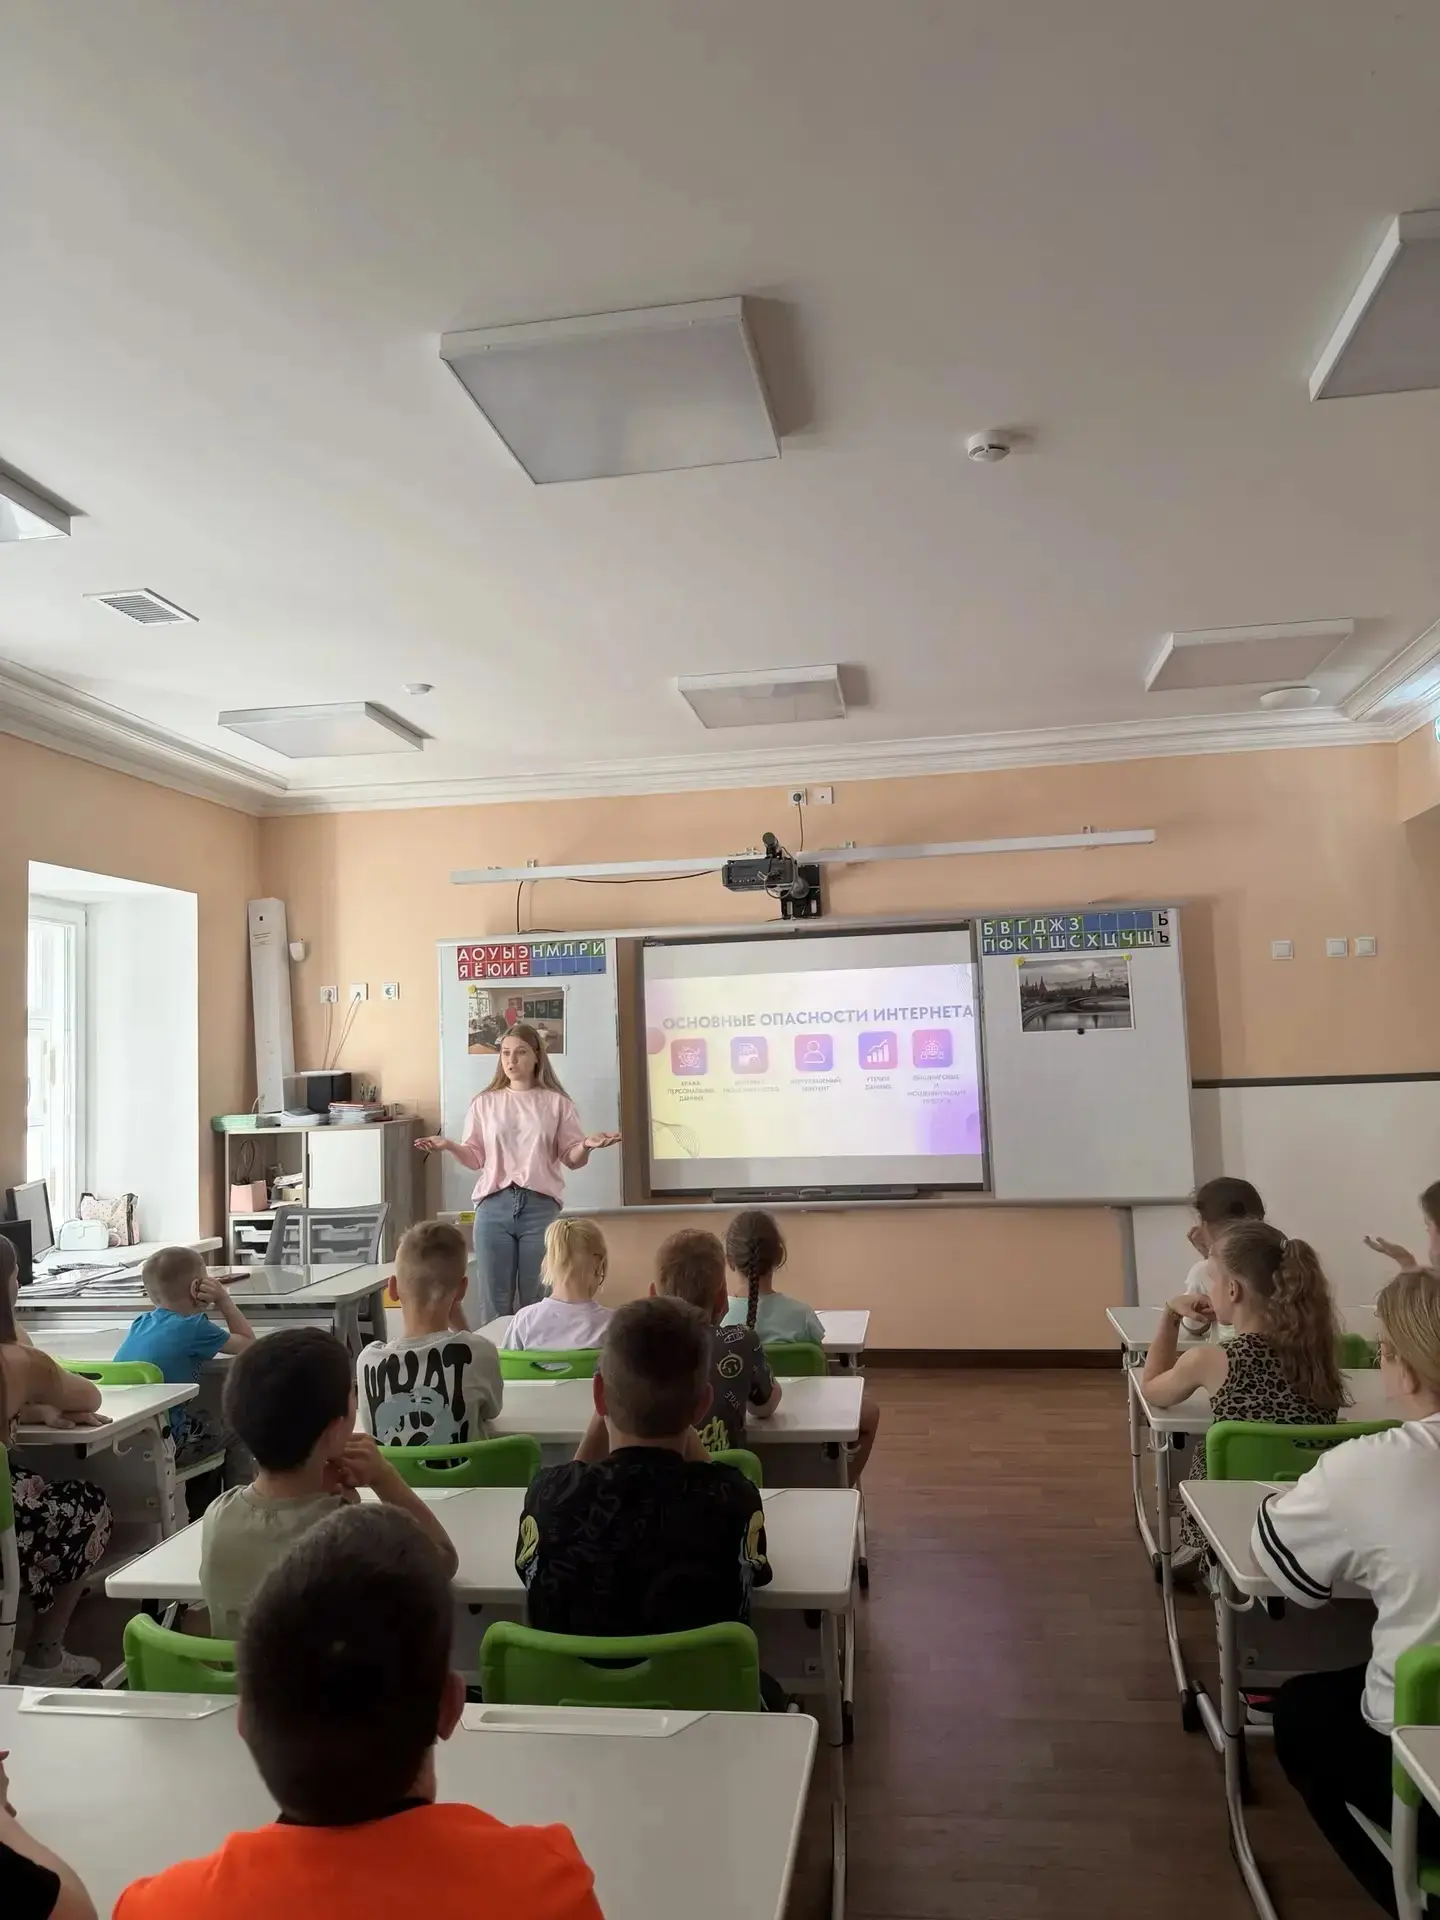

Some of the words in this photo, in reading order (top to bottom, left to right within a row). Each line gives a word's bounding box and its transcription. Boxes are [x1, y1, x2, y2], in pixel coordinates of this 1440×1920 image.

[663, 1014, 756, 1030] ОСНОВНЫЕ
[760, 1007, 869, 1026] ОПАСНОСТИ
[874, 1004, 974, 1021] ИНТЕРНЕТА
